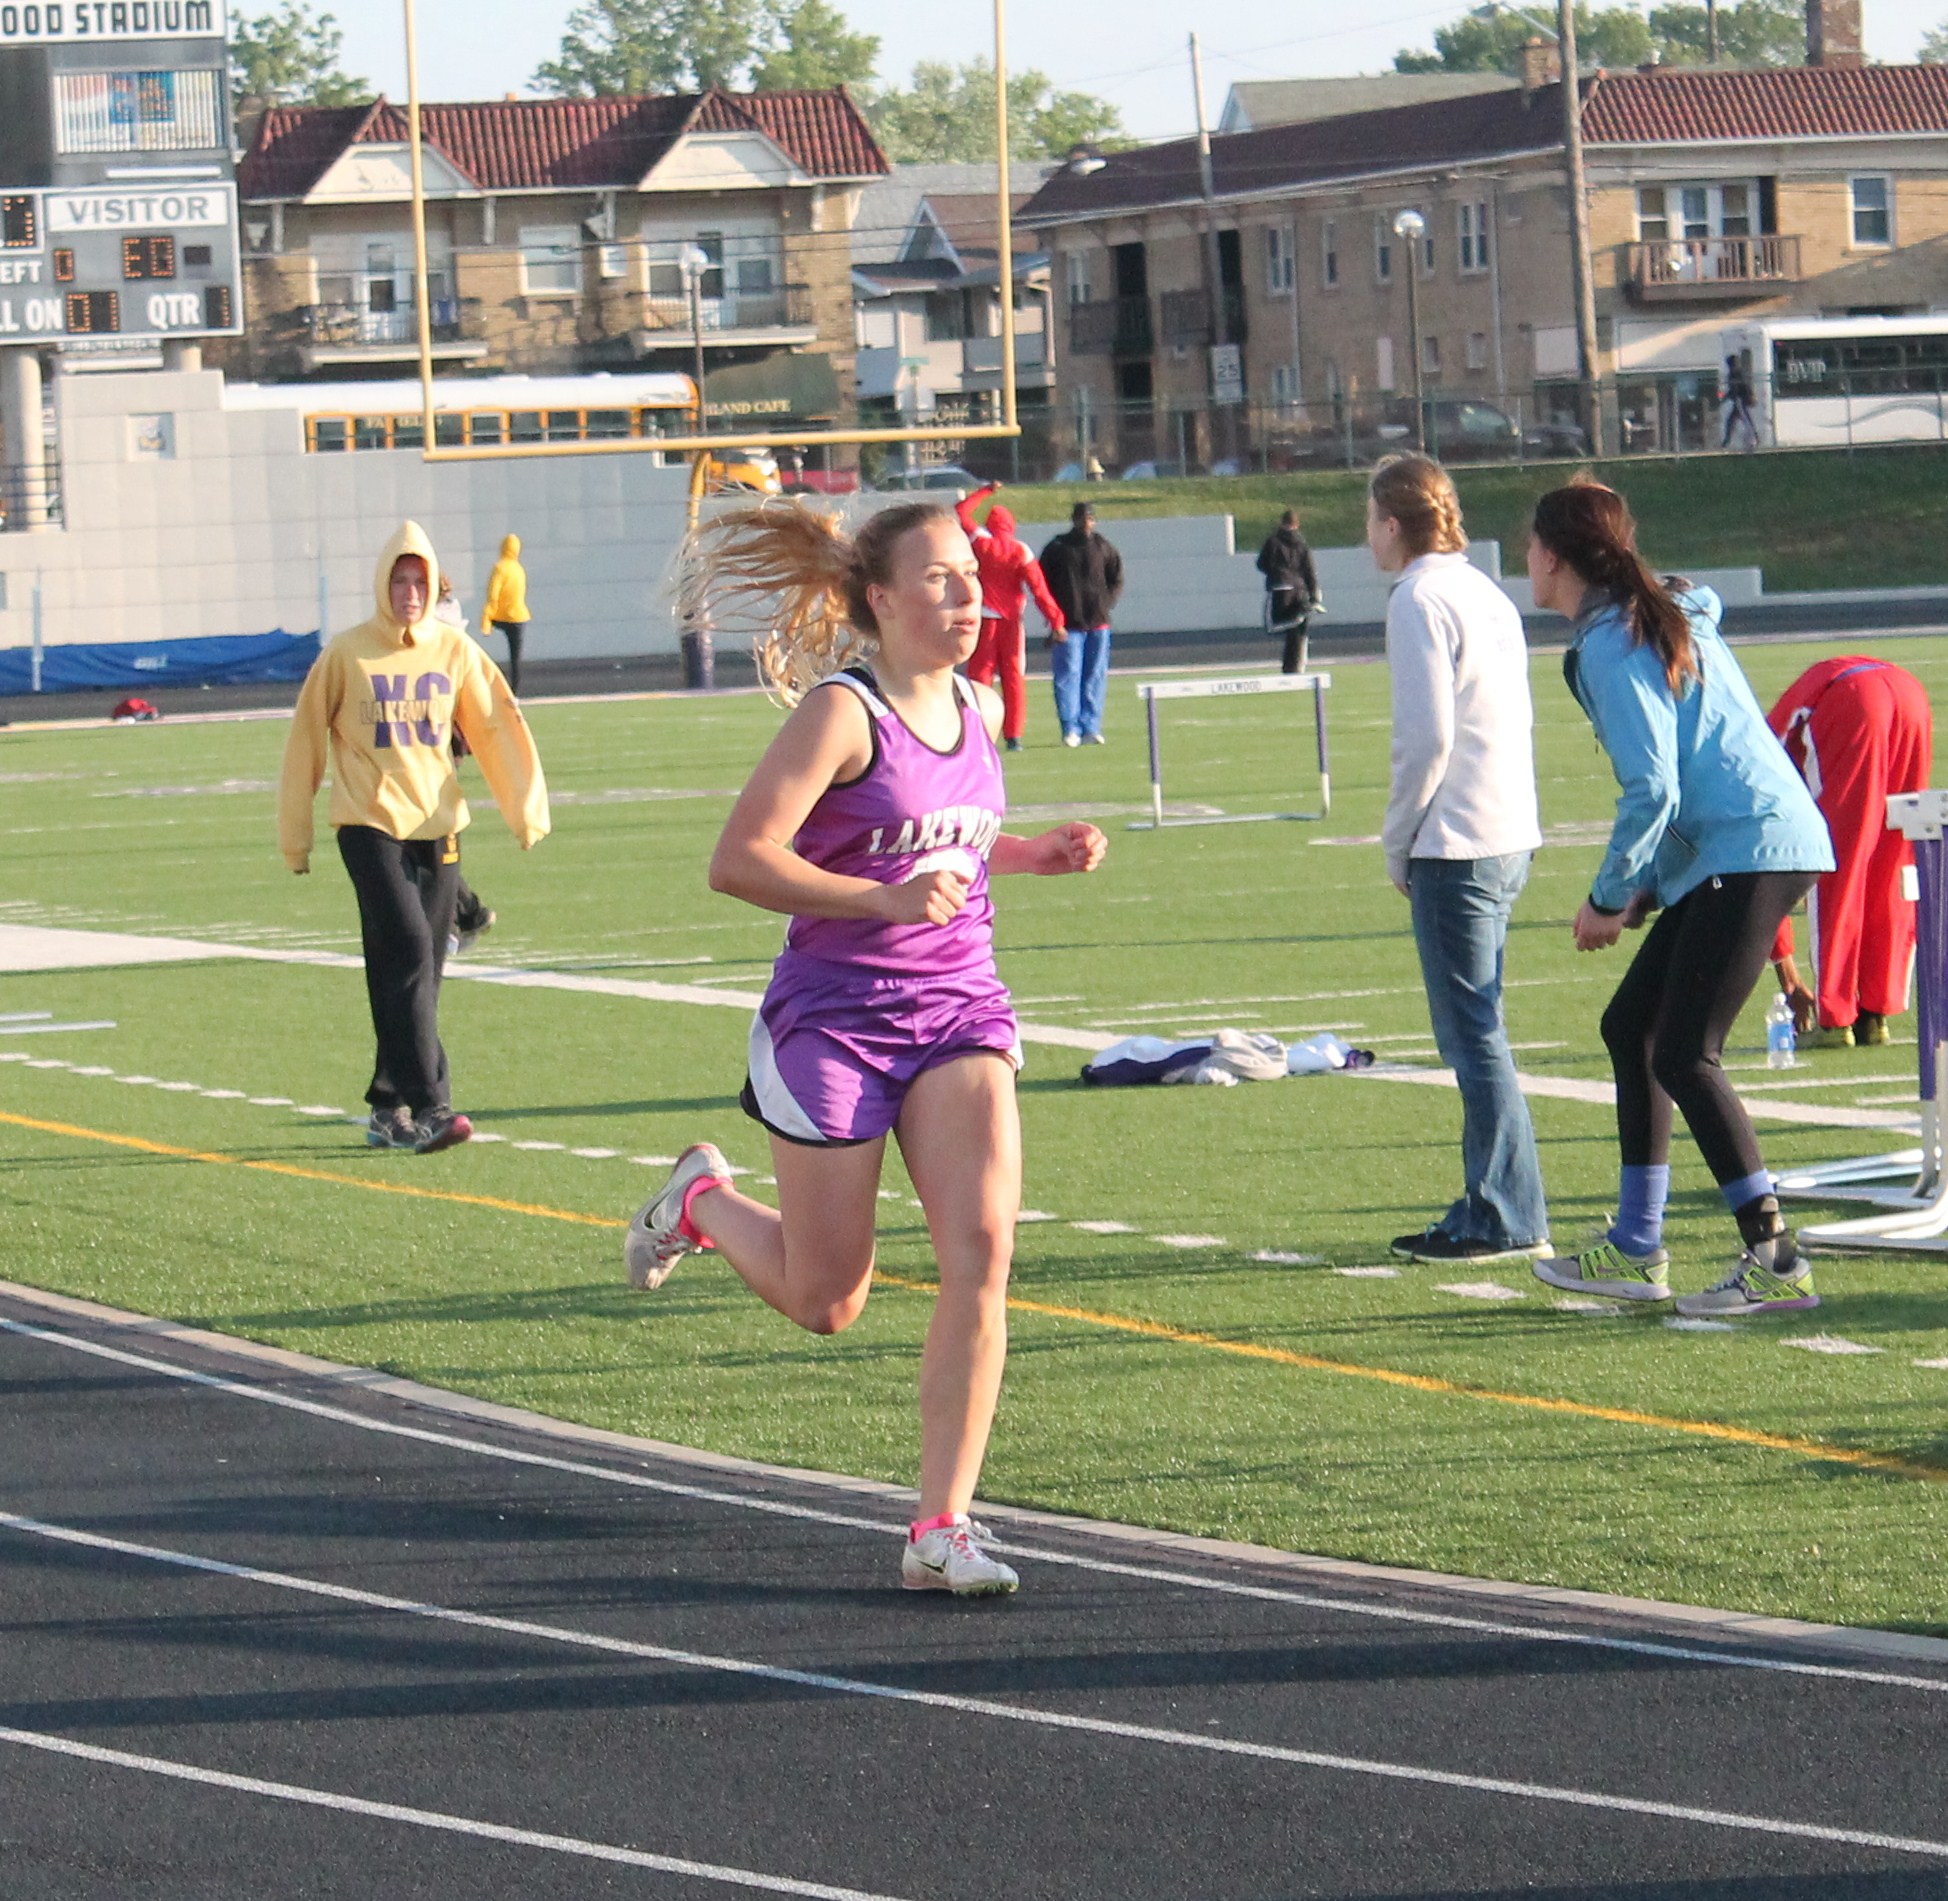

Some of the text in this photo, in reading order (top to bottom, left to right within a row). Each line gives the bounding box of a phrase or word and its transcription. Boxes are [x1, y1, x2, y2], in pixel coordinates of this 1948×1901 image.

[1, 1, 213, 37] OOD STADIUM
[67, 196, 209, 225] VISITOR
[24, 298, 63, 331] ON
[147, 294, 201, 330] QTR
[753, 399, 792, 413] CAFE
[1211, 680, 1262, 694] LAKEWOOD
[359, 699, 452, 725] LAKEWOO
